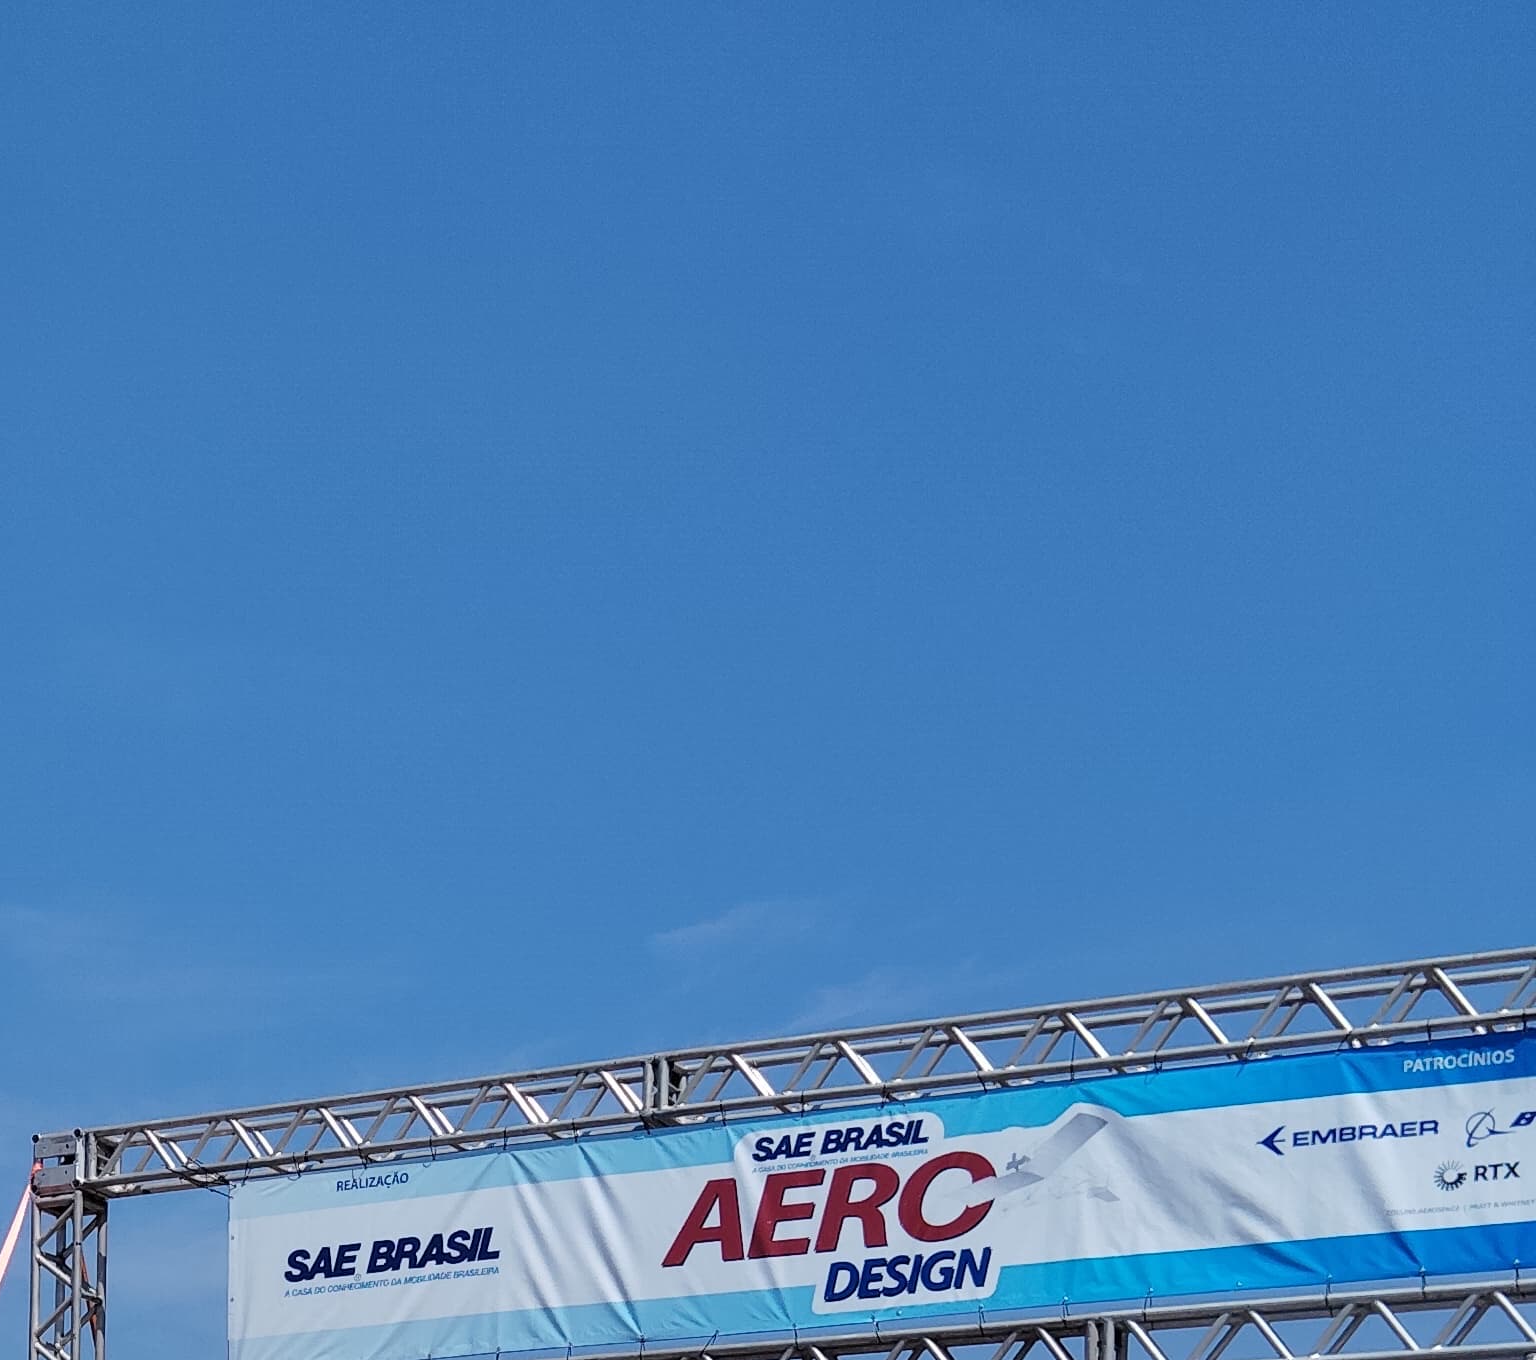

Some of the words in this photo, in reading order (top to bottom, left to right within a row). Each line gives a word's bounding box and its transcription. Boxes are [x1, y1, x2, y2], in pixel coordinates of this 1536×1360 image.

[1403, 1049, 1515, 1072] PATROCÍNIOS
[752, 1131, 816, 1162] SAE
[820, 1119, 929, 1155] BRASIL
[1292, 1119, 1439, 1147] EMBRAER
[336, 1171, 409, 1192] REALIZAÇÃO
[1473, 1161, 1520, 1182] RTX
[284, 1242, 362, 1283] SAE
[366, 1226, 500, 1274] BRASIL
[823, 1246, 992, 1302] DESIGN
